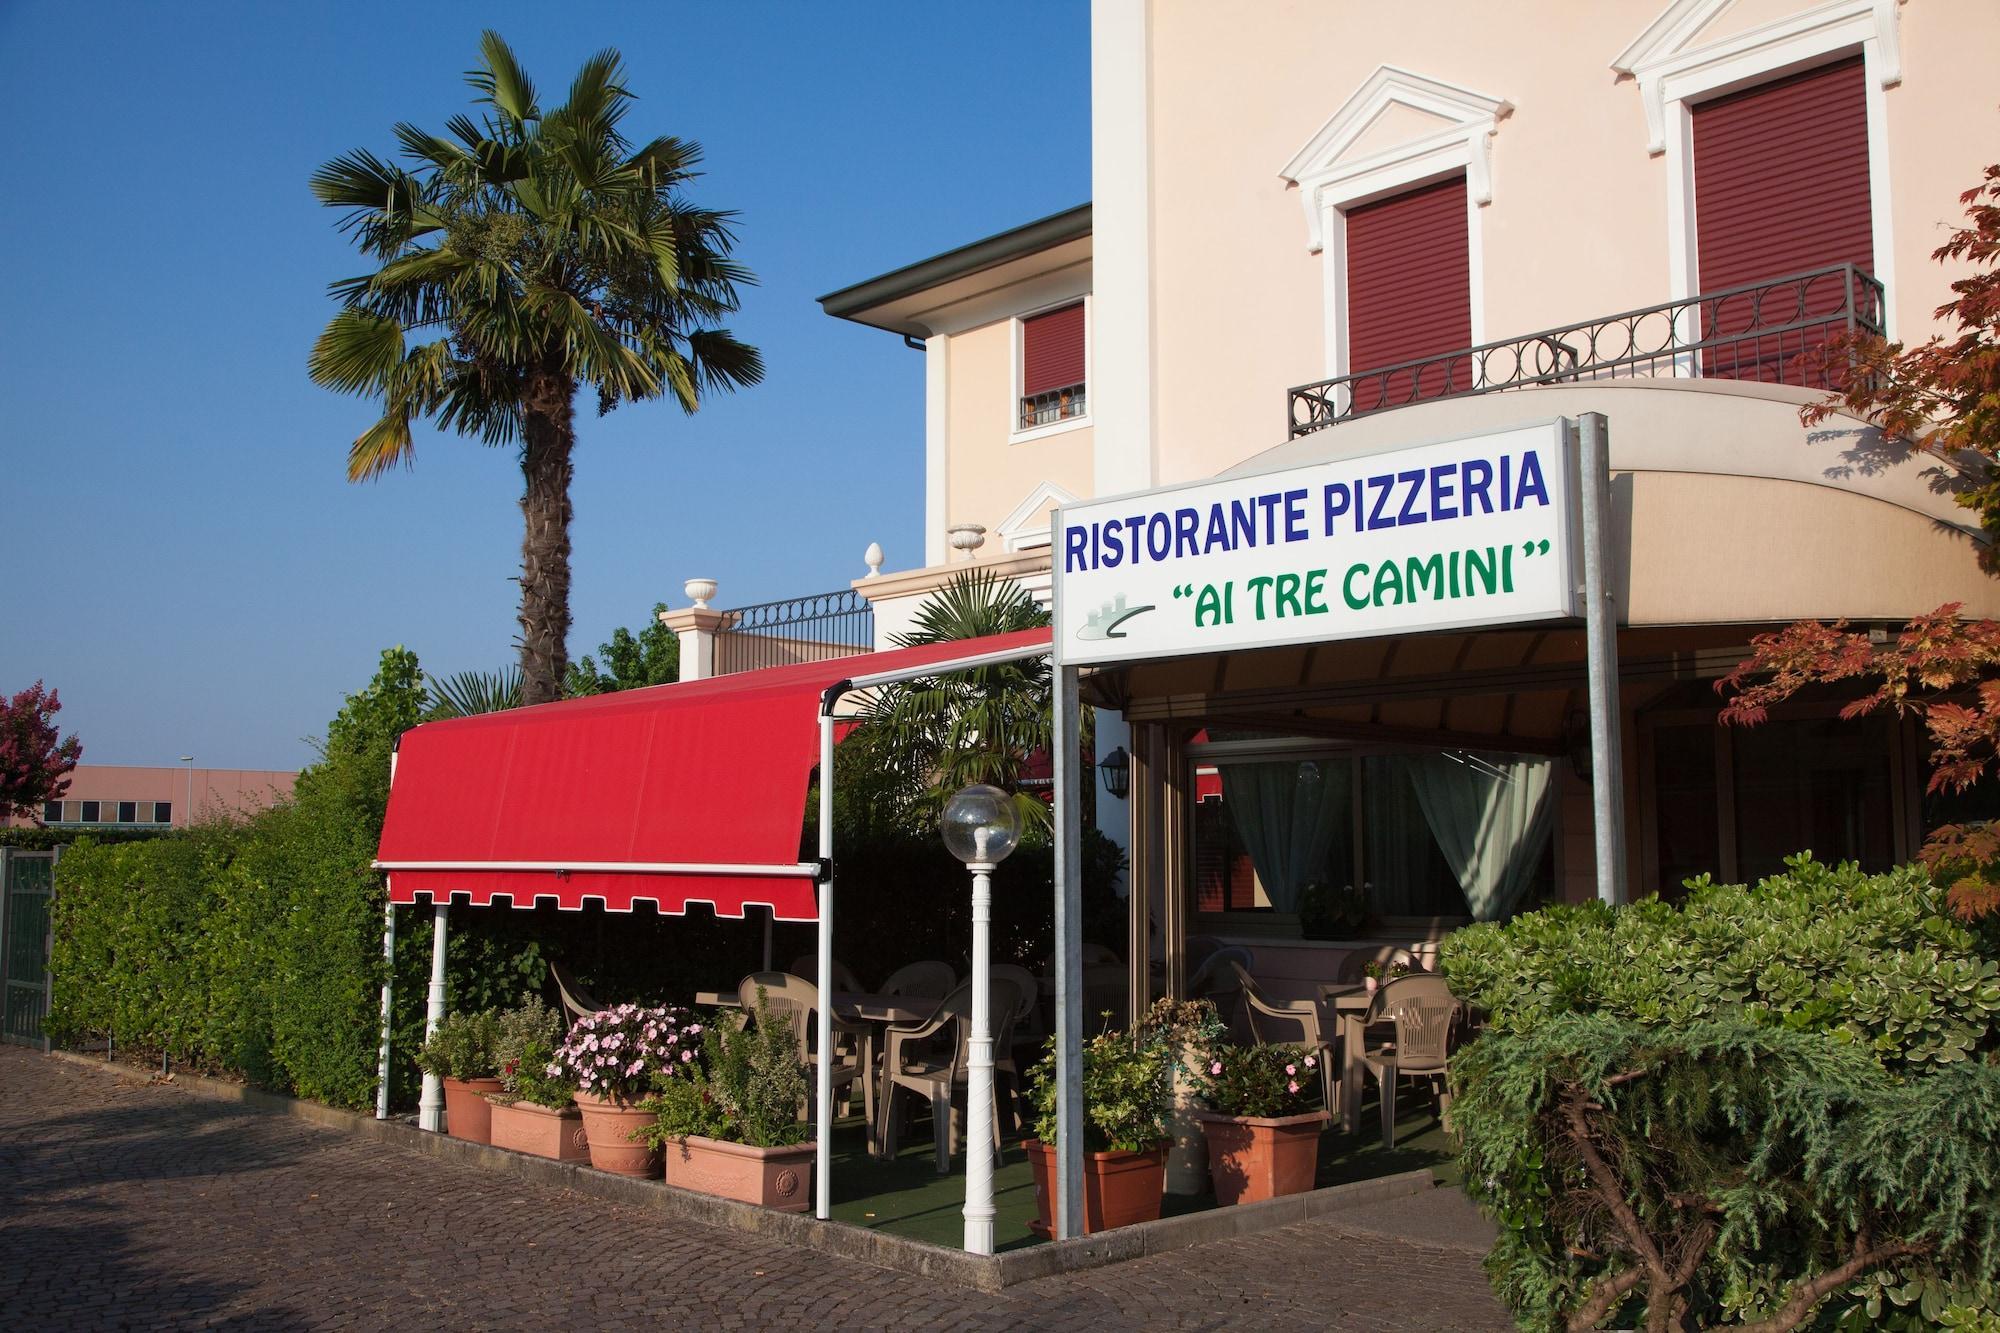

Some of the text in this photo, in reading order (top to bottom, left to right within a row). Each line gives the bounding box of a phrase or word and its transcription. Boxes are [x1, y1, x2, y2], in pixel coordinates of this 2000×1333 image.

[1065, 450, 1550, 573] RISTORANTE PIZZERIA
[1247, 568, 1329, 621] TRE
